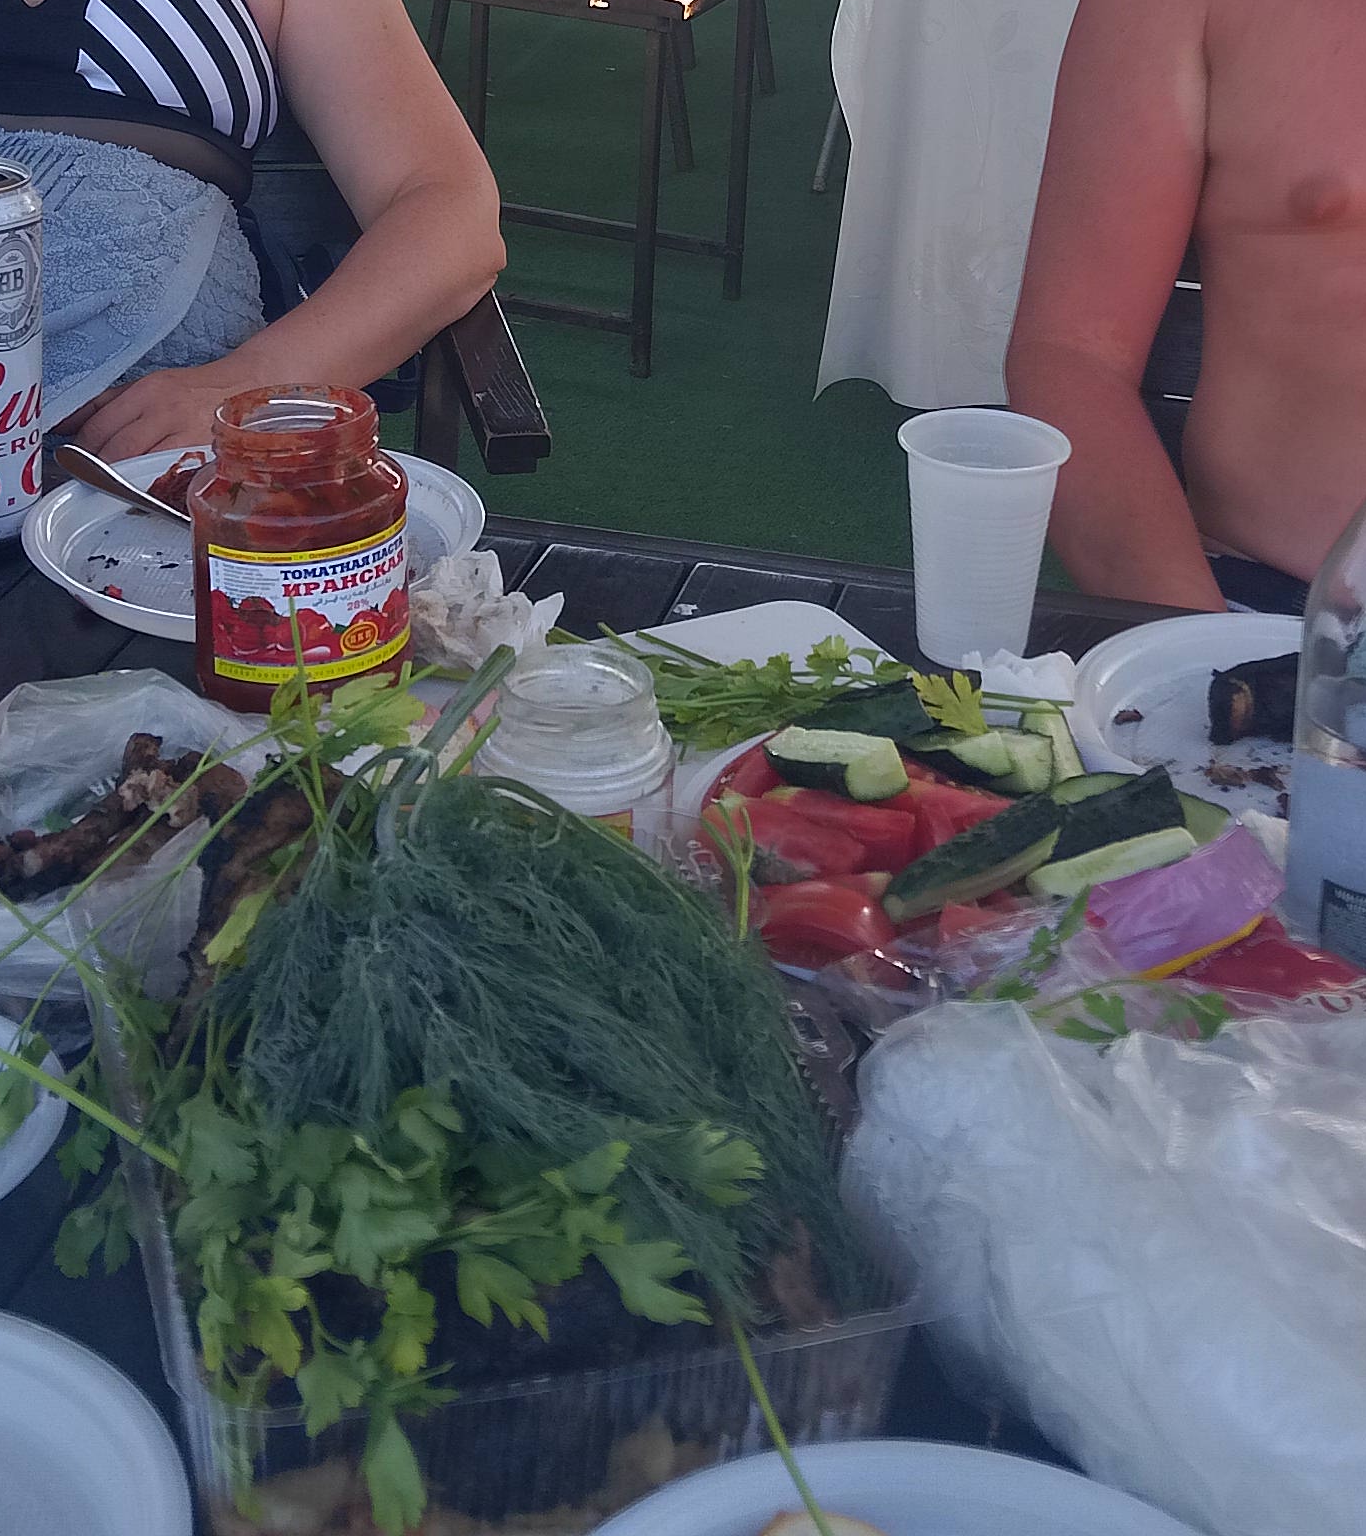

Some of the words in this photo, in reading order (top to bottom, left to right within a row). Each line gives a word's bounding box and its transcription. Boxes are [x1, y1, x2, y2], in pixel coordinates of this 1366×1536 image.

[280, 557, 371, 581] ТОМАТНАЯ
[372, 535, 404, 568] ПАСТА
[282, 548, 404, 598] ИРАНСКАЯ
[346, 597, 371, 611] 28%
